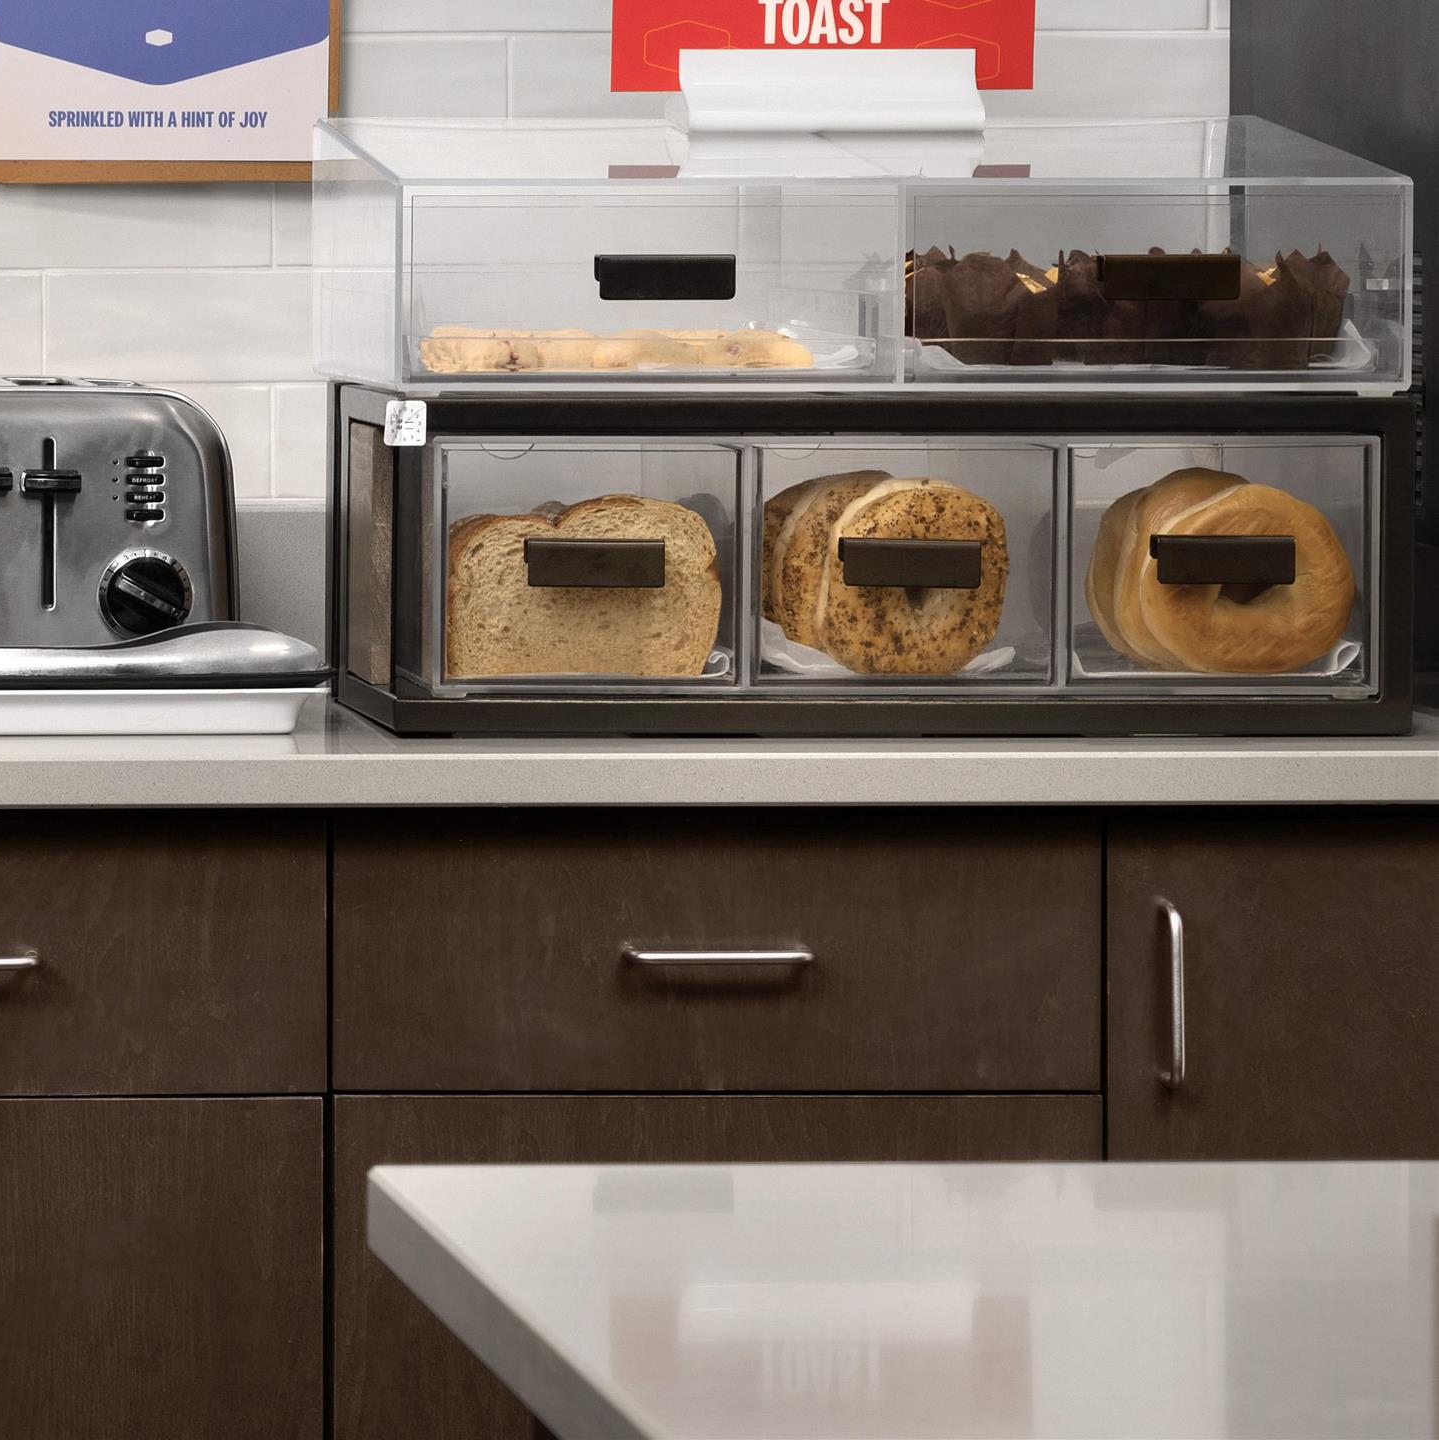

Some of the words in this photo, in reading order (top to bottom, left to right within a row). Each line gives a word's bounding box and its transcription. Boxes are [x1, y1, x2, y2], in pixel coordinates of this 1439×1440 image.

[48, 110, 125, 128] SPRINKLED
[127, 110, 164, 128] WITH
[167, 111, 178, 127] A
[181, 111, 214, 128] HINT
[218, 111, 236, 128] OF
[238, 111, 268, 129] JOY
